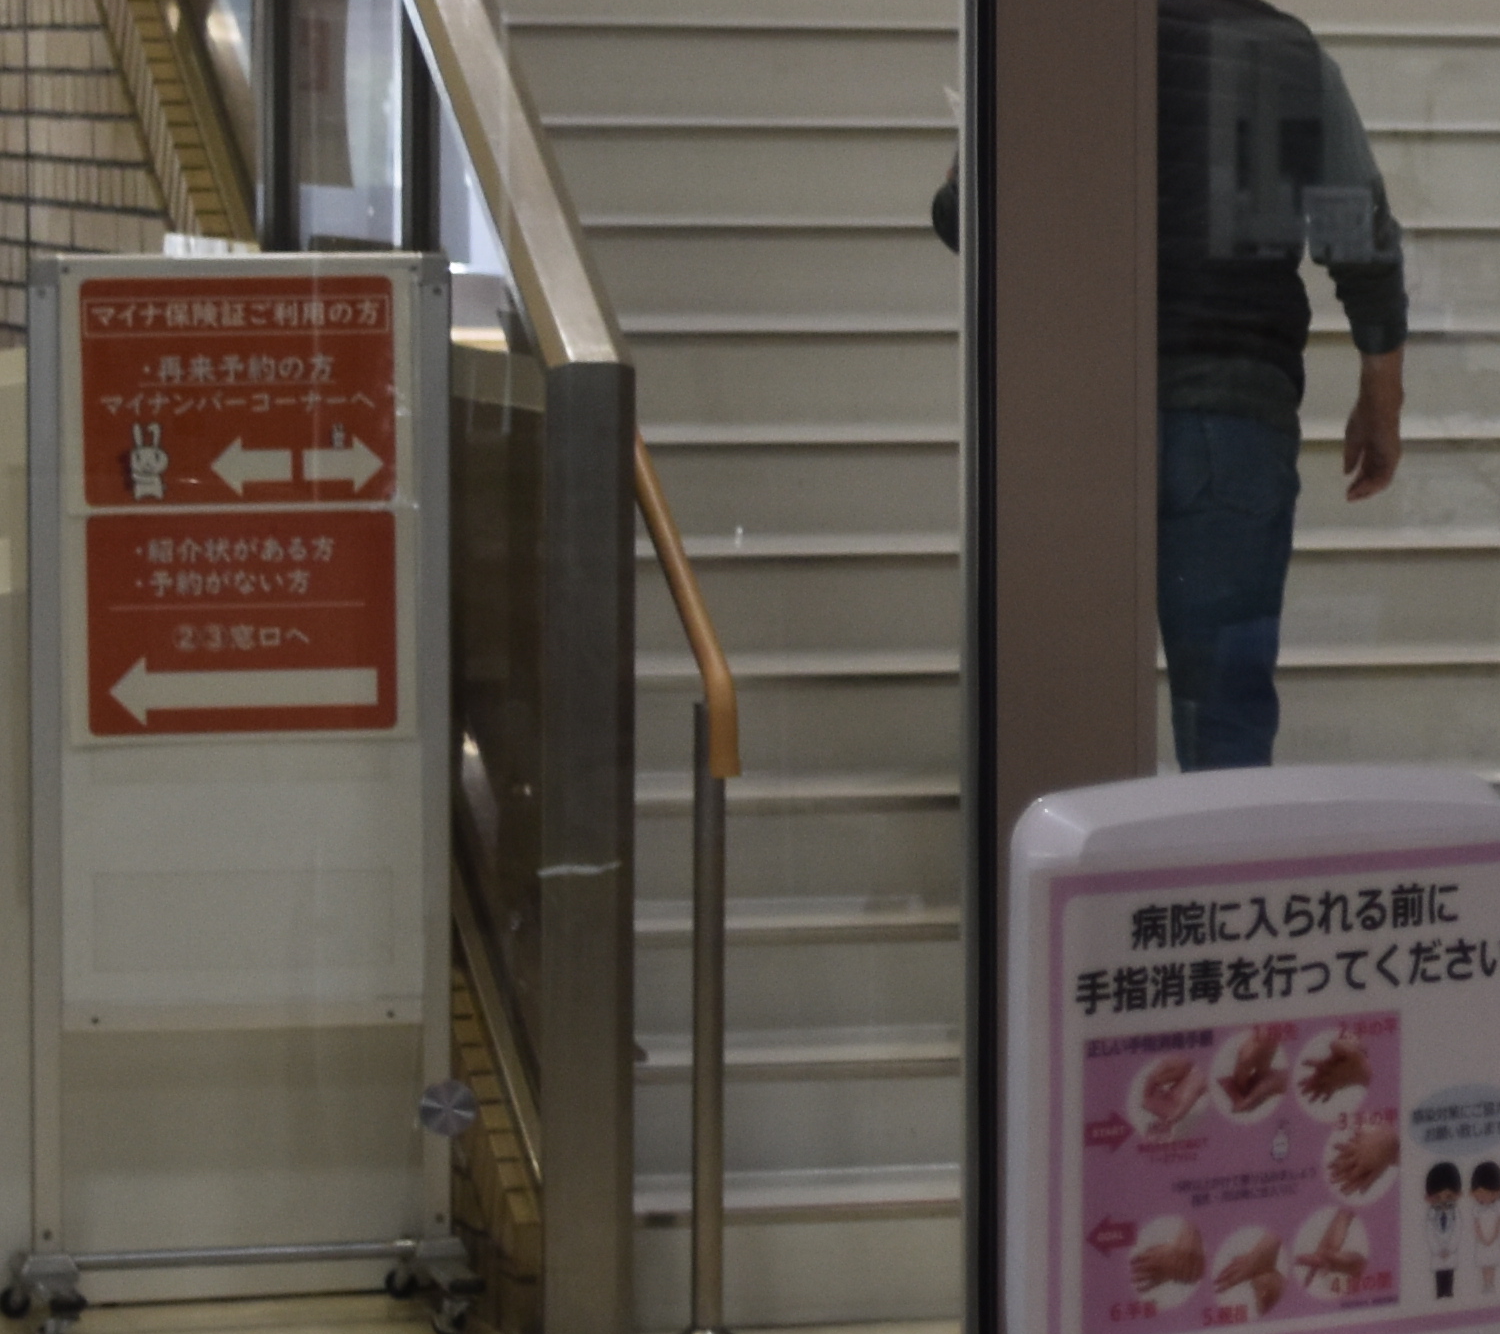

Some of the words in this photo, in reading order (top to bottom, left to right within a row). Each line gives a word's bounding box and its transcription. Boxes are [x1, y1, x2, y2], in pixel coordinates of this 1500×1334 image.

[91, 299, 382, 328] マイナ保険証ご利用の方
[101, 393, 376, 417] マイナンバーコーナーへ
[1131, 883, 1460, 951] 病院に入られる前に
